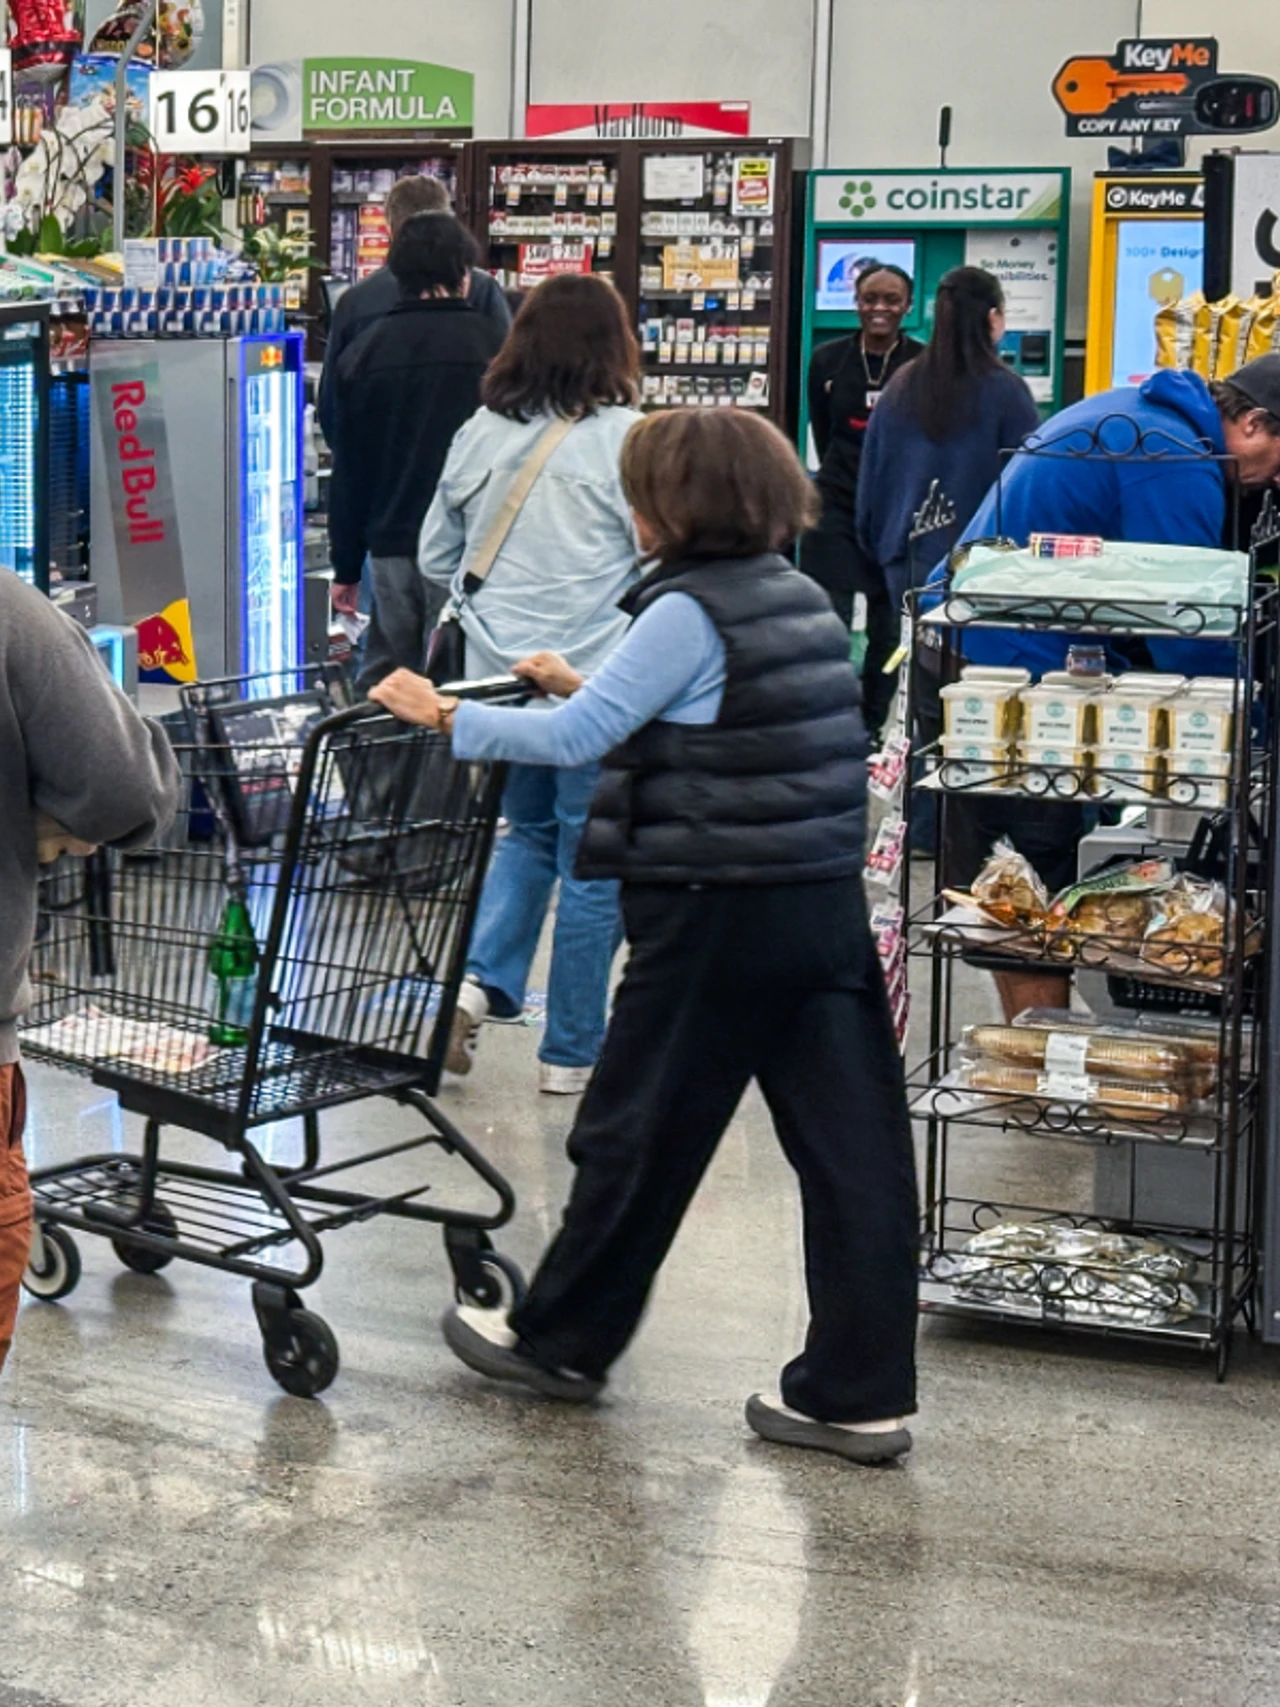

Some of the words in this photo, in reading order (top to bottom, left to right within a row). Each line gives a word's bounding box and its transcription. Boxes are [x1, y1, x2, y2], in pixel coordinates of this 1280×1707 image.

[1123, 43, 1211, 71] KeyMe
[309, 69, 416, 94] INFANT
[156, 88, 219, 135] 16
[228, 89, 248, 134] 16
[309, 96, 457, 121] FORMULA
[1077, 118, 1118, 133] COPY
[1118, 118, 1151, 132] ANY
[1152, 117, 1181, 131] KEY
[886, 180, 1030, 211] coinstar
[1129, 189, 1186, 208] KeyMe
[998, 258, 1036, 271] Money
[110, 379, 155, 461] Red
[120, 466, 165, 545] Bull
